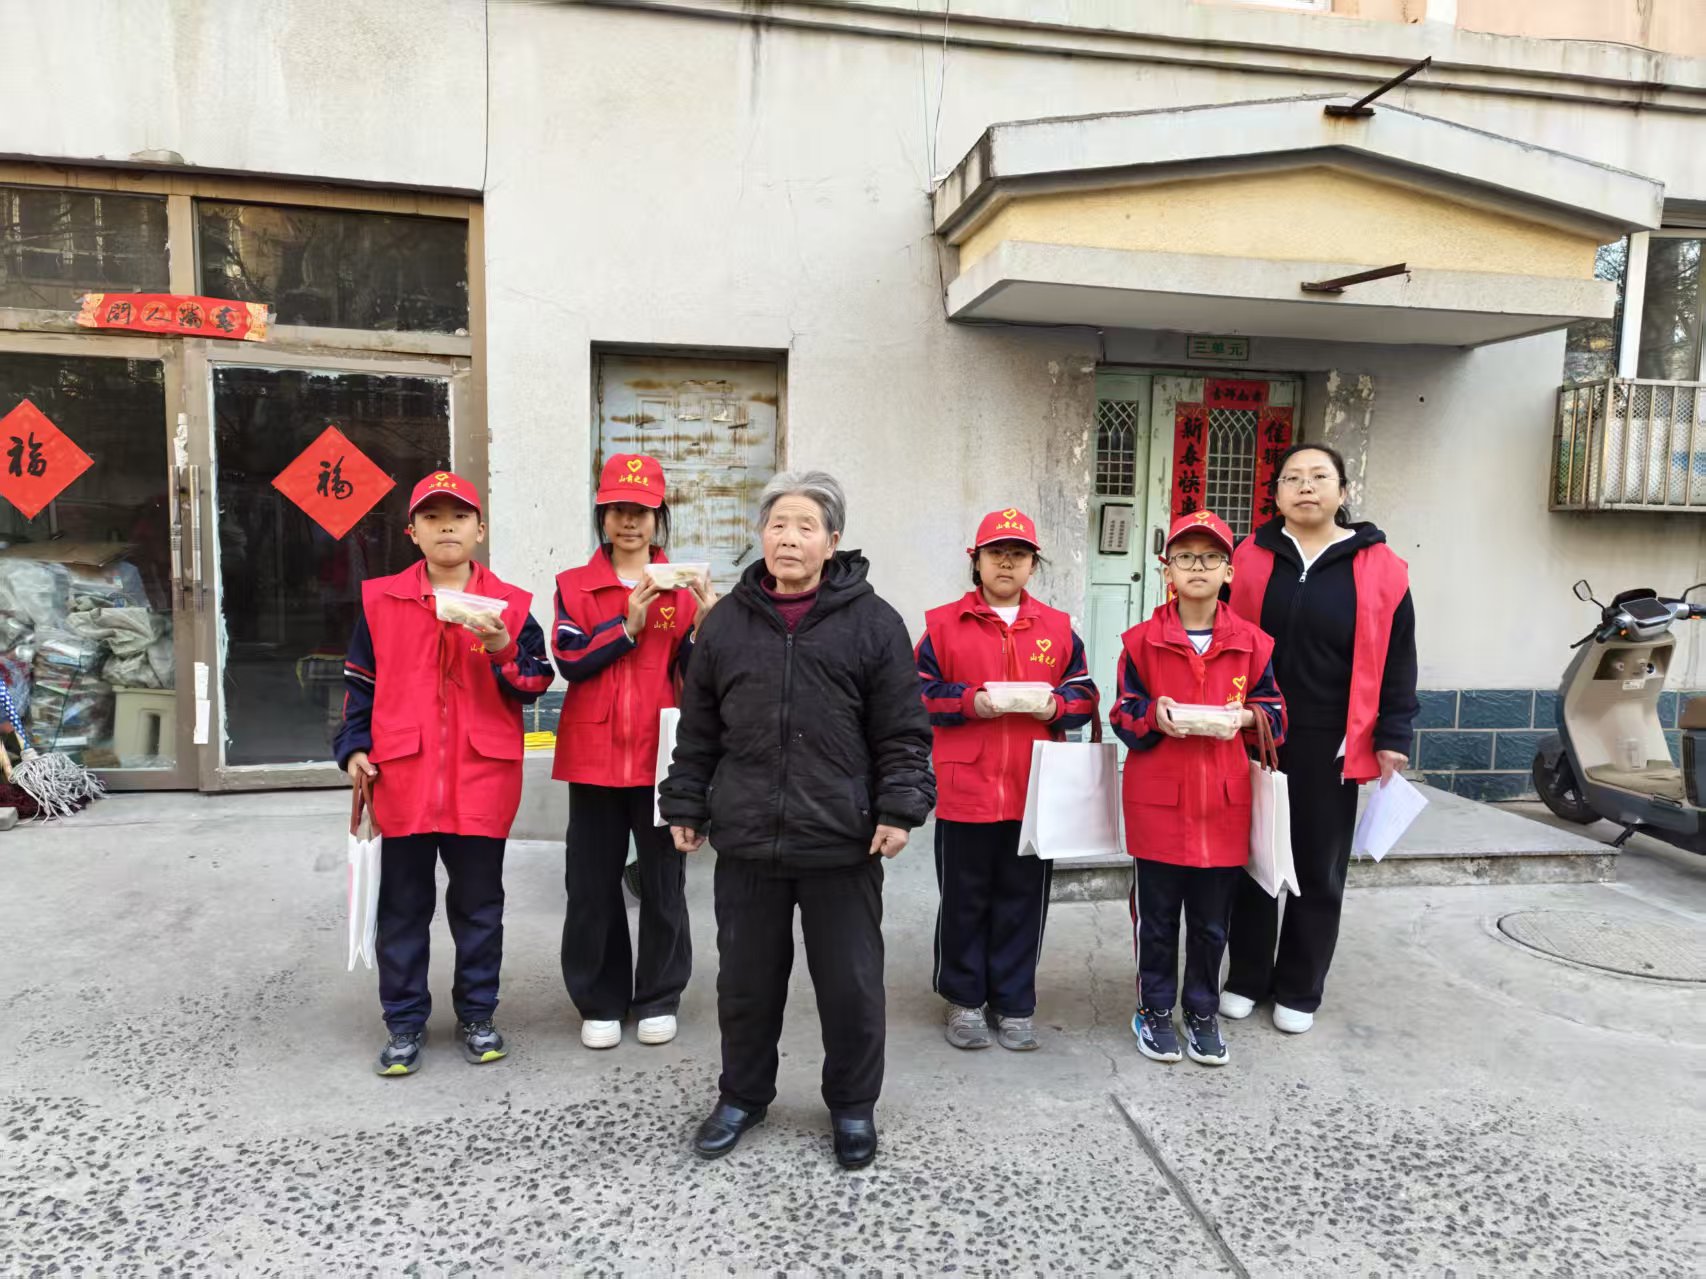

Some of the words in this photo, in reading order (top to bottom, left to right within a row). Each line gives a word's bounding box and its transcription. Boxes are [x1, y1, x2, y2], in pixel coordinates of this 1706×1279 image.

[1194, 340, 1243, 356] 三单元
[7, 432, 48, 478] 福
[316, 455, 353, 500] 福
